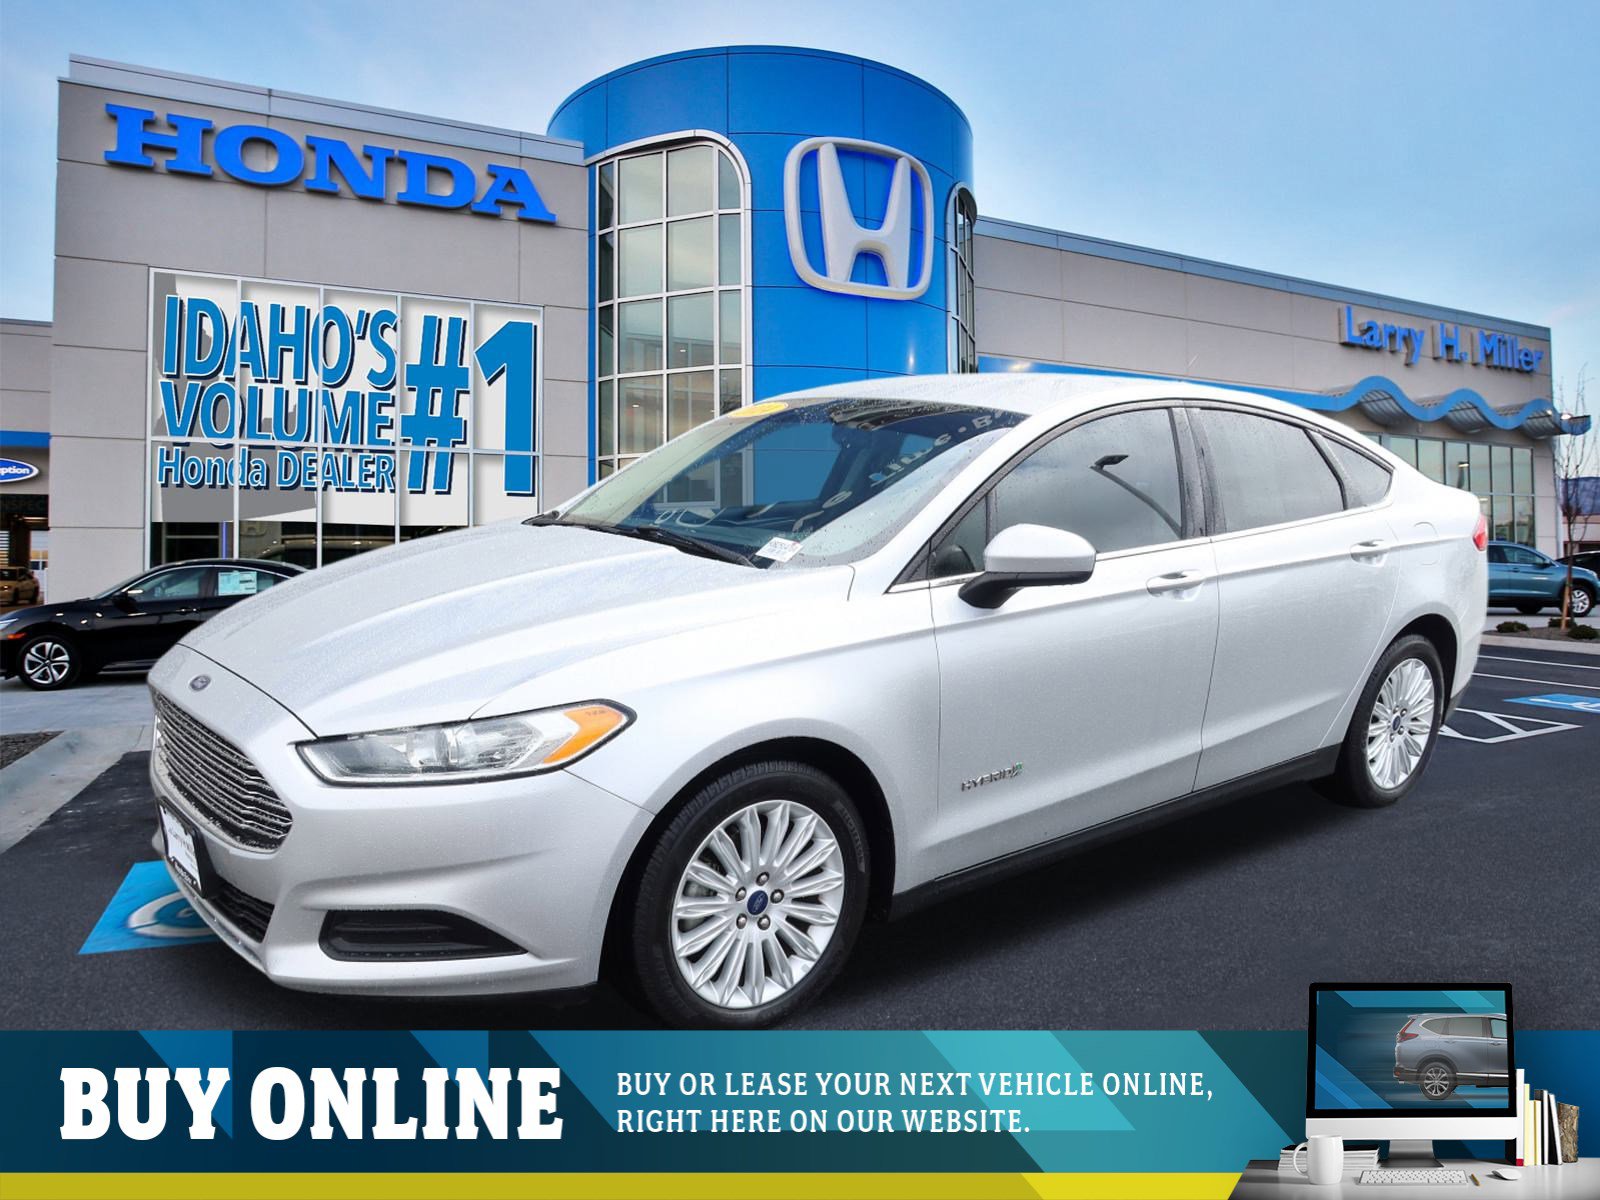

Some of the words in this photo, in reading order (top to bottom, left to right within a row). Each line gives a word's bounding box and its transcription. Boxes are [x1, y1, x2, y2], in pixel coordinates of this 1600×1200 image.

[104, 103, 557, 223] HONDA
[163, 294, 399, 391] IDAHO'S
[1344, 305, 1425, 367] Larry
[1438, 322, 1469, 362] H.
[1478, 329, 1545, 373] Miller
[159, 380, 397, 449] VOLUME
[400, 315, 538, 497] #1
[0, 466, 30, 476] ption
[157, 446, 270, 490] Honda
[275, 450, 397, 493] DEALER
